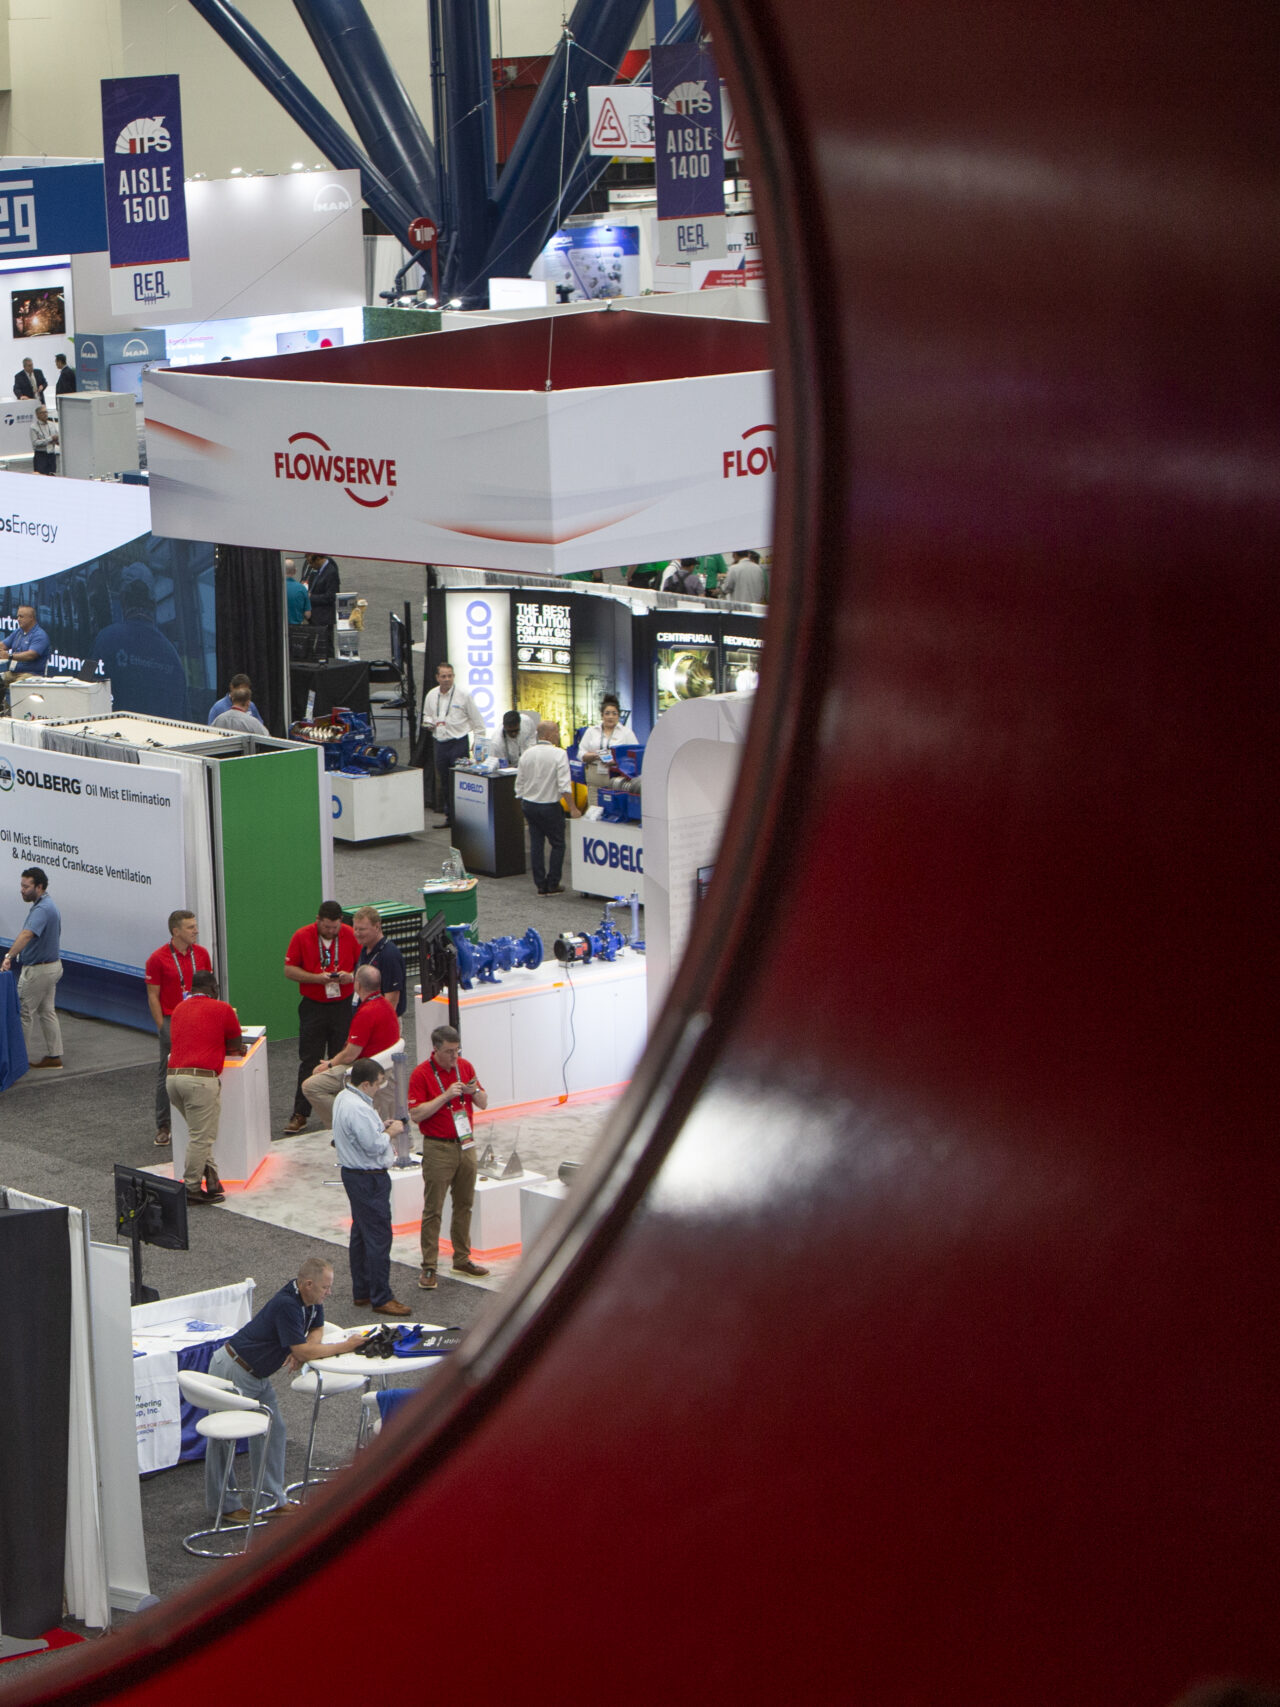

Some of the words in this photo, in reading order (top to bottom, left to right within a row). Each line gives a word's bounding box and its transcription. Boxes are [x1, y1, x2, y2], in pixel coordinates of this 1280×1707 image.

[666, 127, 713, 153] AISLE
[671, 154, 710, 180] 1400
[119, 166, 172, 195] AISLE
[123, 196, 170, 224] 1500
[274, 452, 397, 487] FLOWSERVE
[516, 603, 539, 616] THE
[542, 604, 571, 618] BEST
[516, 614, 571, 629] SOLUTION
[516, 626, 535, 636] FOR
[536, 627, 554, 637] ANY
[554, 628, 571, 639] GAS
[517, 635, 571, 646] COMPRESSION
[656, 632, 716, 643] CENTRIFUGAL
[16, 768, 81, 795] SOLBERG
[85, 783, 98, 797] Oil
[100, 786, 119, 800] Mist
[121, 789, 171, 807] Elimination
[458, 781, 484, 794] KOBELCO
[0, 829, 12, 843] Oil
[13, 832, 31, 845] Mist
[33, 835, 79, 855] Eliminators
[12, 847, 19, 859] &
[21, 849, 61, 867] Advanced
[62, 857, 104, 876] Crankcase
[105, 865, 152, 885] Ventilation
